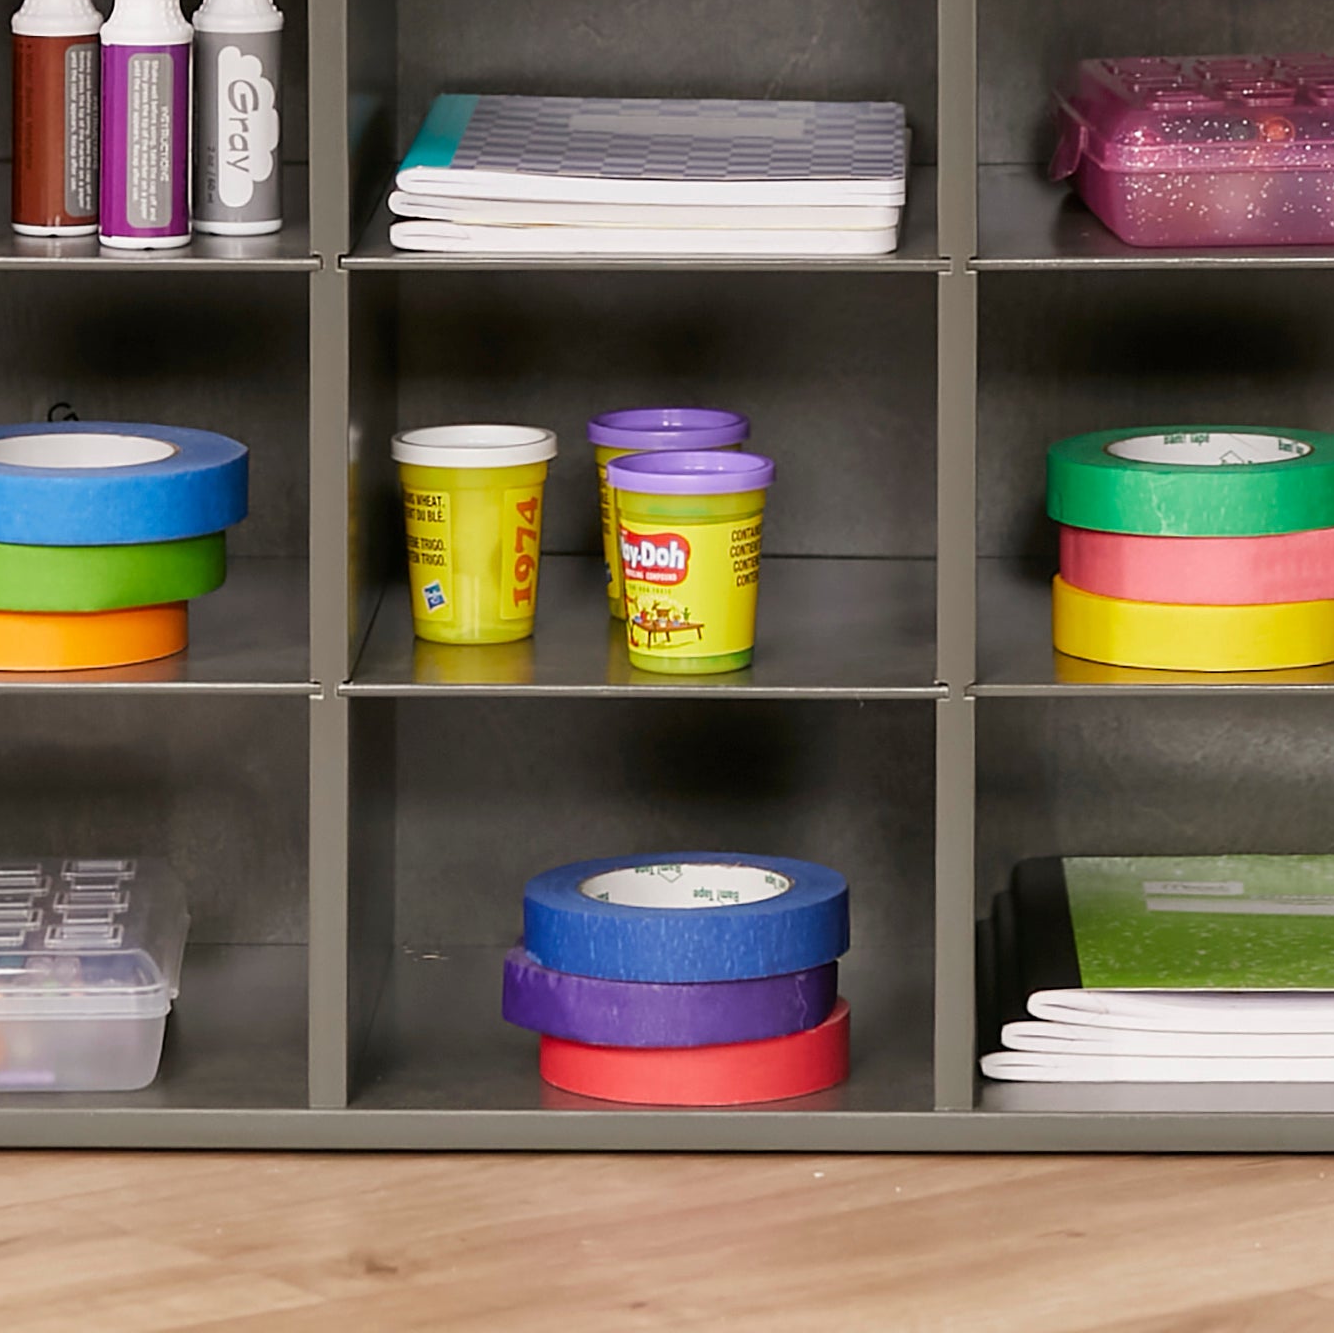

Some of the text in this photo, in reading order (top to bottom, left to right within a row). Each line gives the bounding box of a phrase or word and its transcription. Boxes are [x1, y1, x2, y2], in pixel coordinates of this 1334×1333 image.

[226, 80, 260, 173] Gray
[160, 105, 170, 182] INSTRUCTIONS
[731, 524, 761, 542] CONTAI
[420, 537, 446, 551] TRIGO.
[513, 496, 538, 608] 1974
[620, 536, 686, 569] ay-Doh
[730, 540, 761, 558] CONTIE
[421, 552, 446, 566] TRIGO.
[693, 887, 713, 901] Tape
